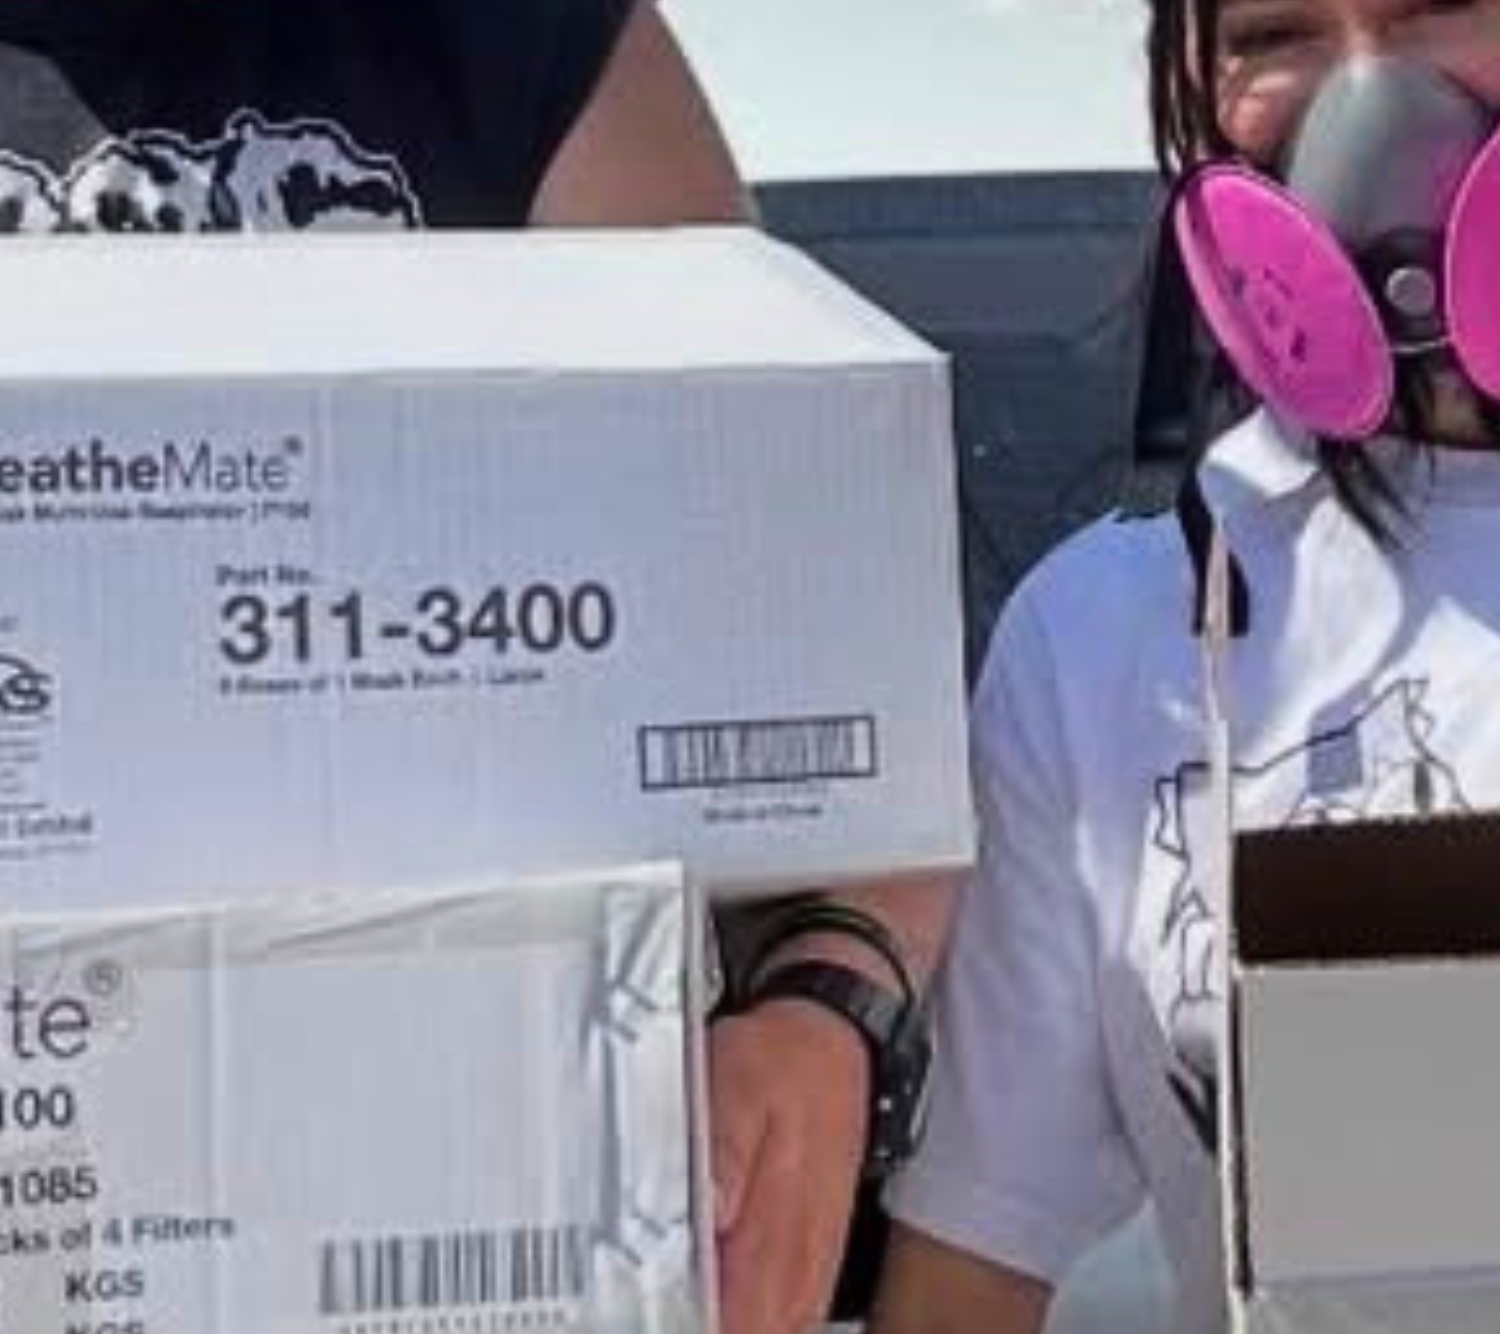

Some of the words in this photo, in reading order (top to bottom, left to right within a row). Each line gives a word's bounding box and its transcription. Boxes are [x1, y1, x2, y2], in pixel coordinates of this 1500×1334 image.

[219, 580, 617, 666] 311-3400
[60, 1223, 92, 1252] of
[101, 1220, 122, 1246] 4
[131, 1216, 236, 1244] Filters
[64, 1269, 145, 1303] KGS
